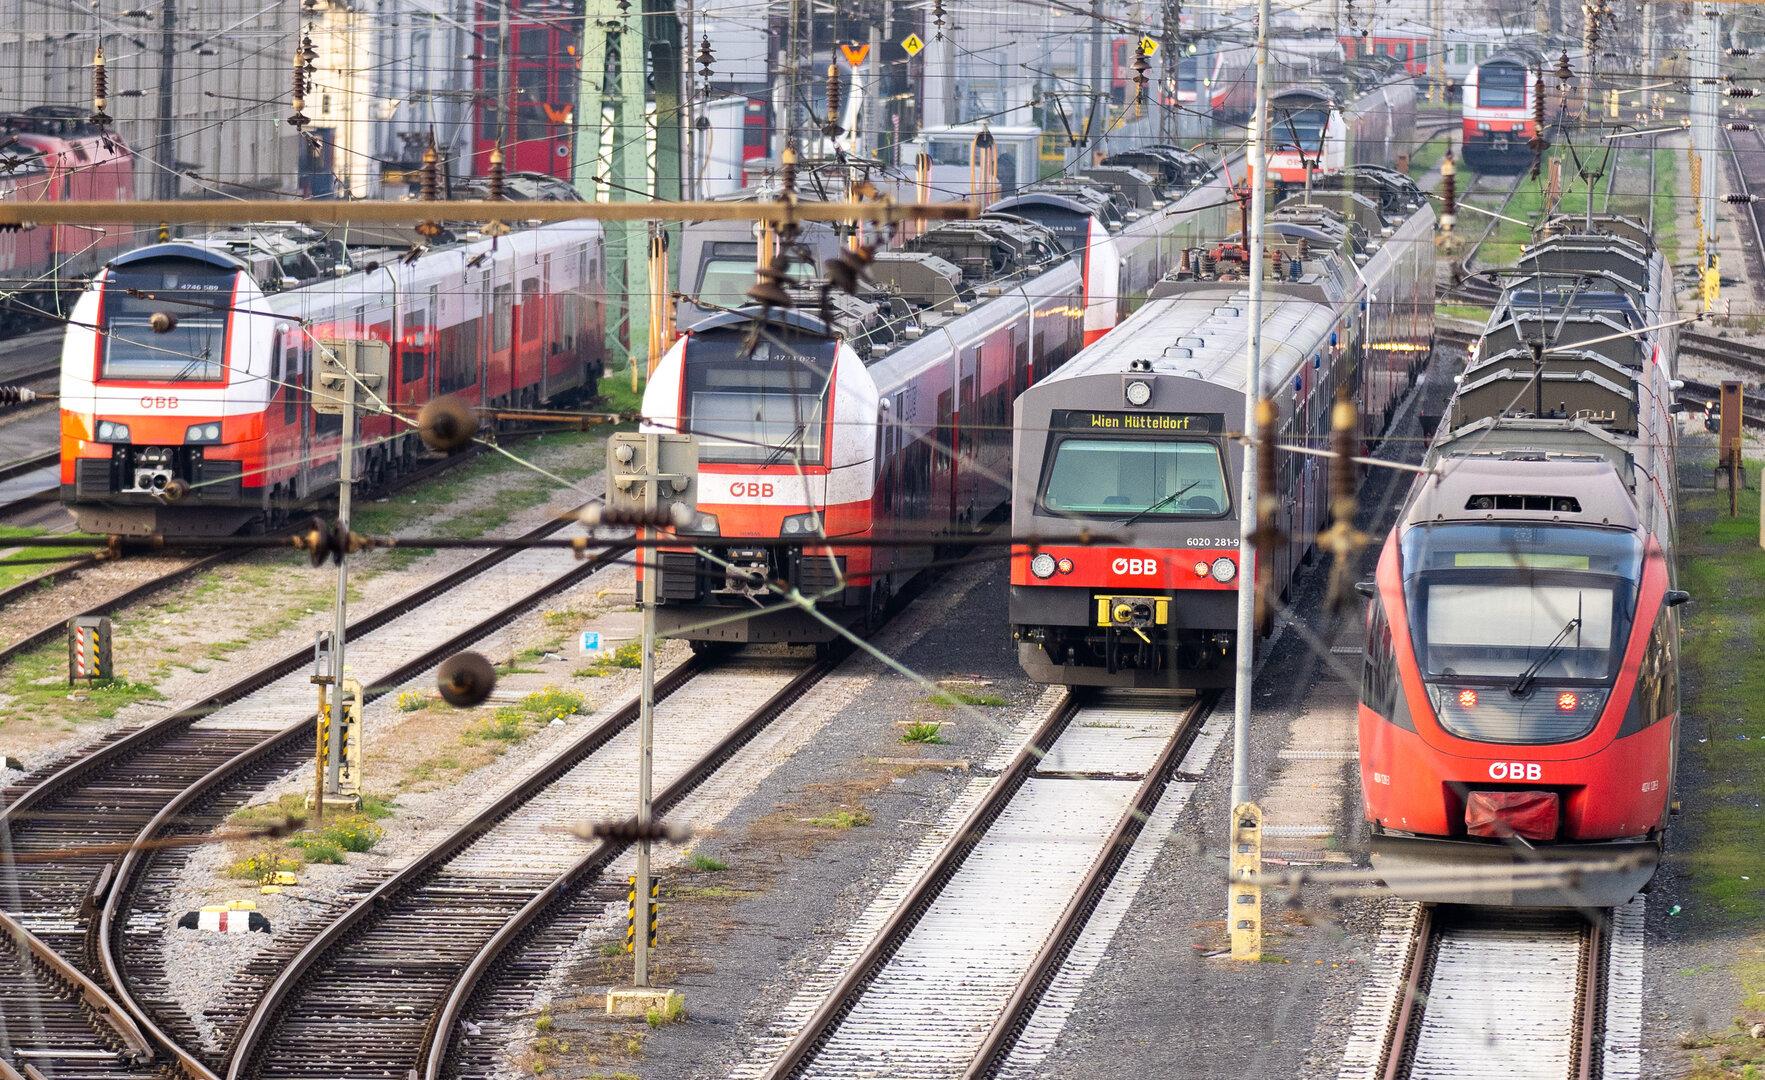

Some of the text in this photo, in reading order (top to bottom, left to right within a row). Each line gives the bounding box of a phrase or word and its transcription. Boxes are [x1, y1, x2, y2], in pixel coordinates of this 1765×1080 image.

[908, 38, 918, 49] A
[1144, 40, 1154, 50] A
[141, 396, 178, 408] ÖBB
[1091, 414, 1190, 430] Wien Hütteldorf
[730, 482, 774, 497] ÖBB
[1186, 538, 1240, 546] 6020 281-9
[1112, 558, 1157, 575] ÖBB
[1488, 762, 1542, 780] ÖBB
